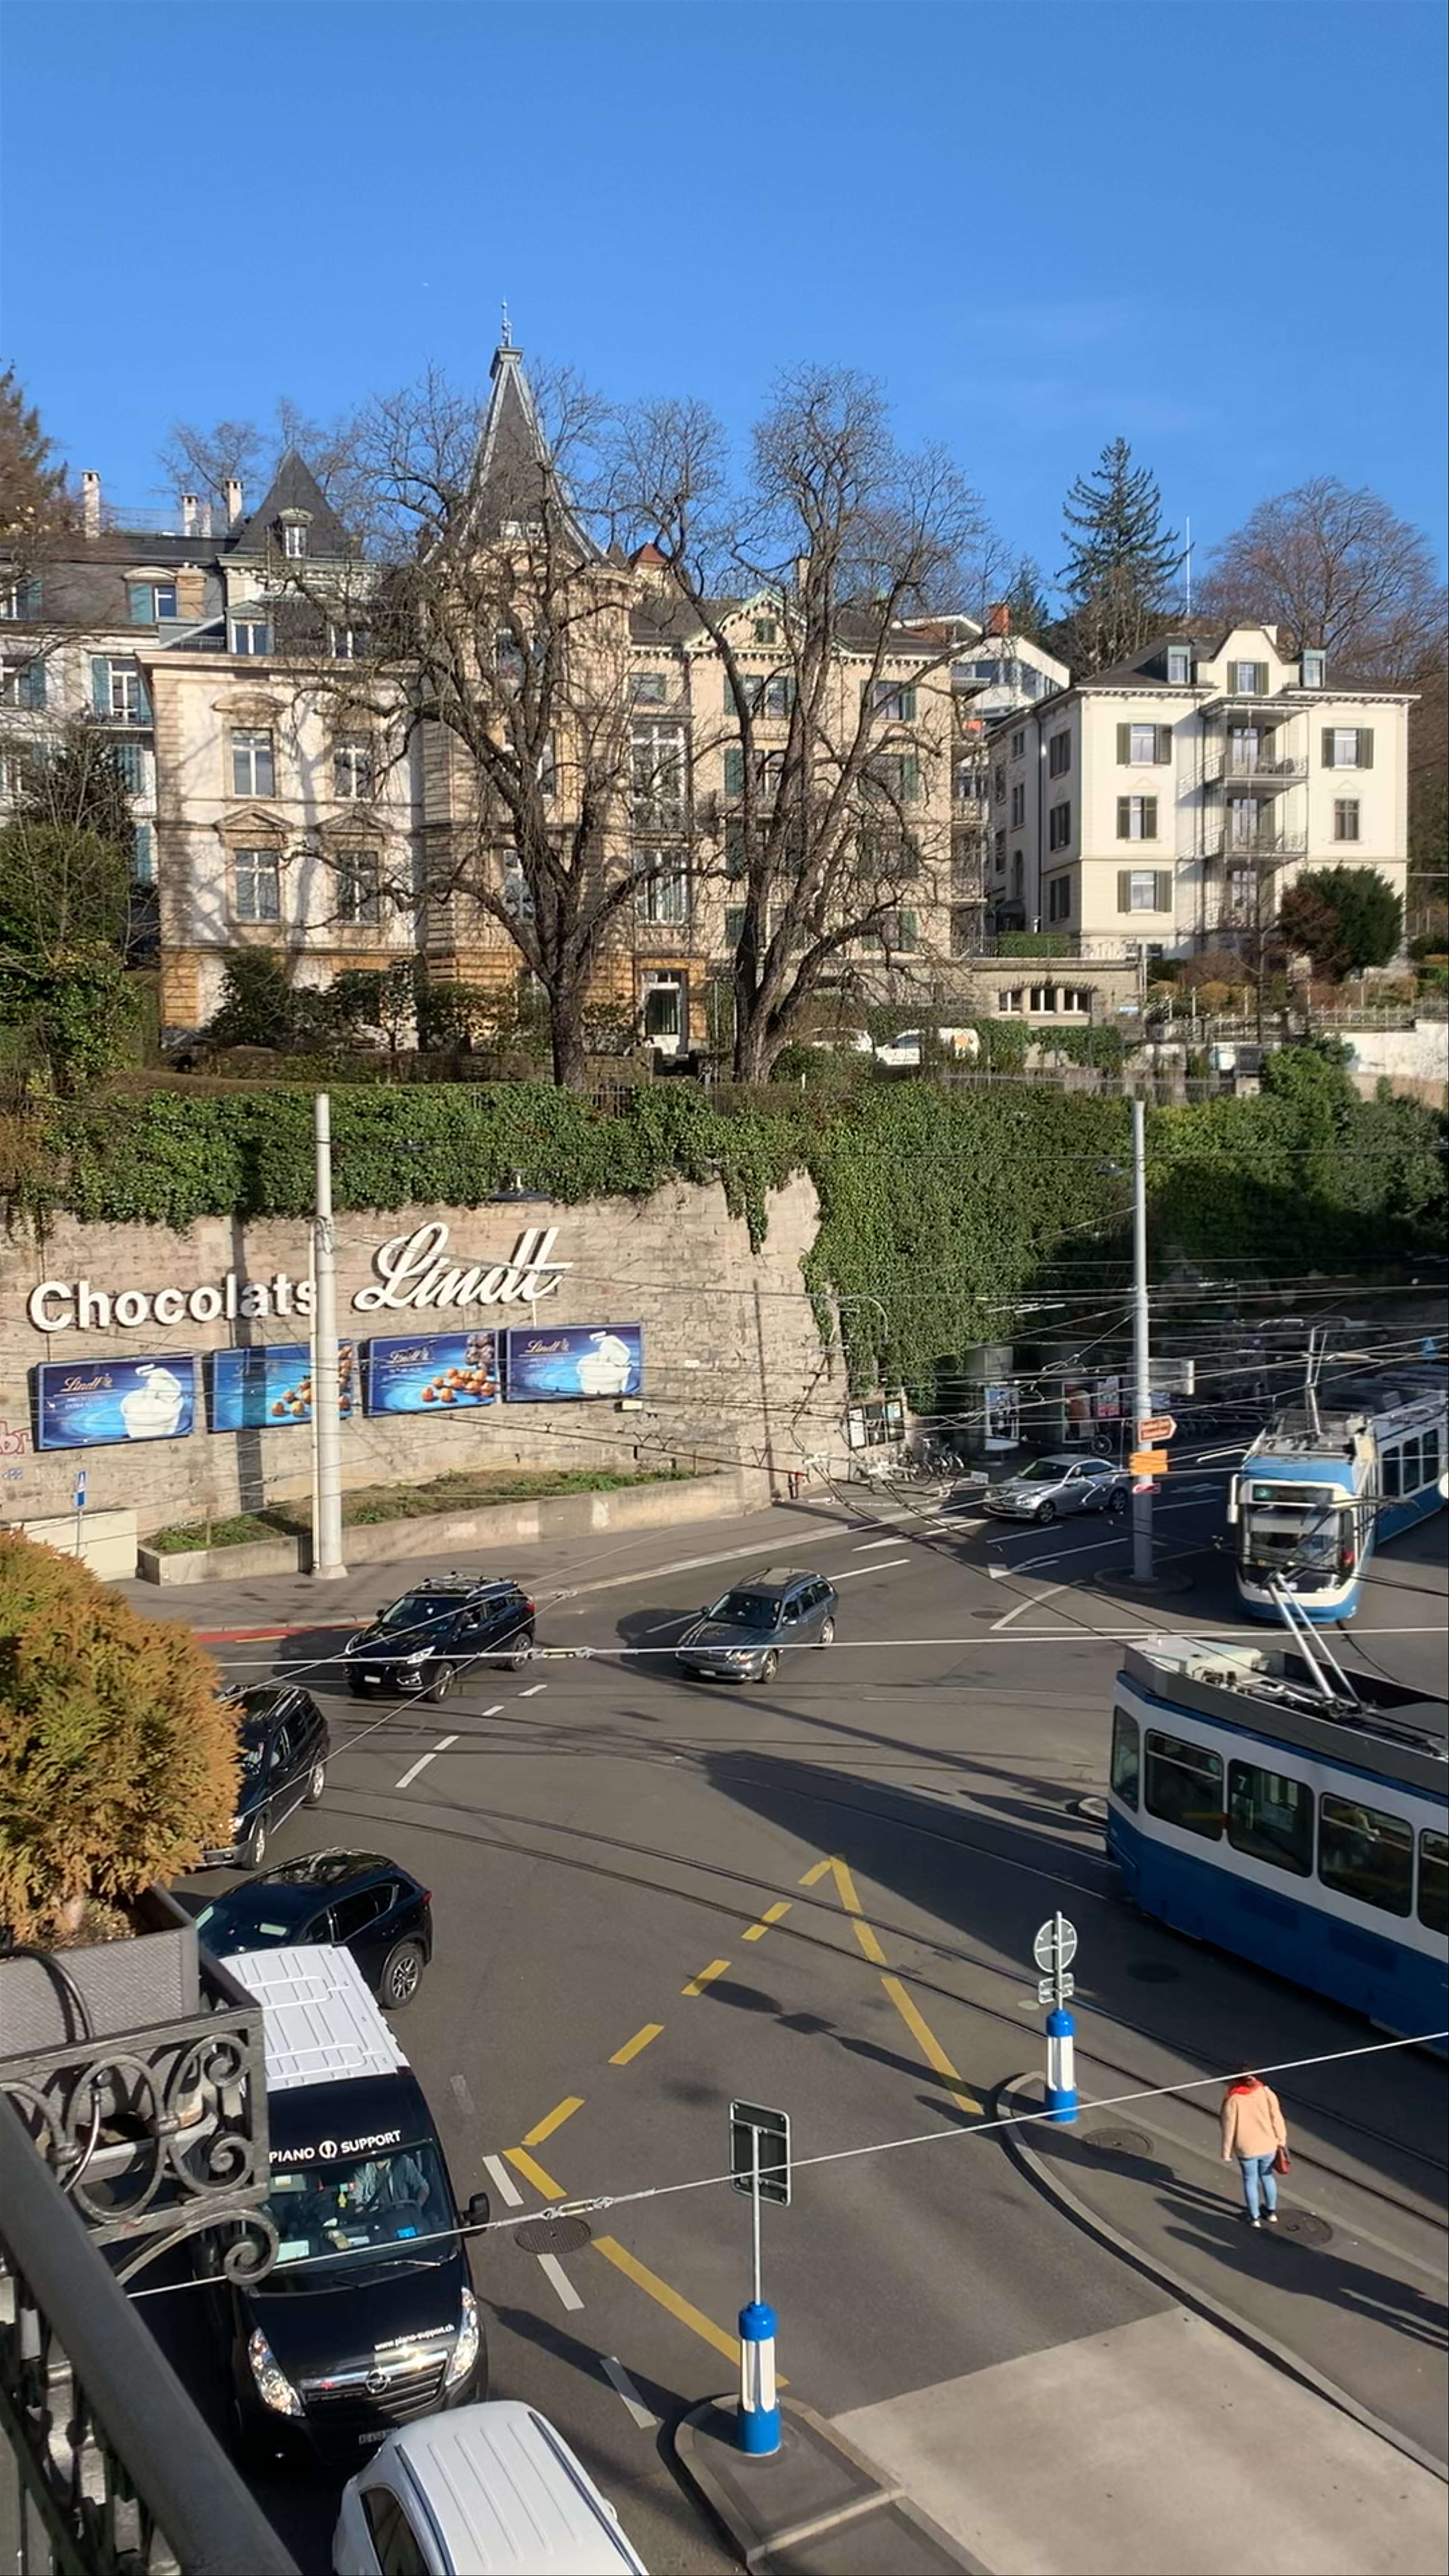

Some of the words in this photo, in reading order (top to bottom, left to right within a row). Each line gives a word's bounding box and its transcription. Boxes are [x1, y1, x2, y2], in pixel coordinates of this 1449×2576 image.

[28, 1273, 316, 1332] Chocolats
[354, 1222, 573, 1311] Lindt
[525, 1340, 560, 1353] Lindt
[60, 1376, 102, 1392] Lindt
[1237, 1775, 1247, 1790] 7
[269, 2147, 315, 2163] PIANO
[341, 2130, 401, 2154] SUPPORT
[374, 2323, 455, 2351] www.piano-support.ch
